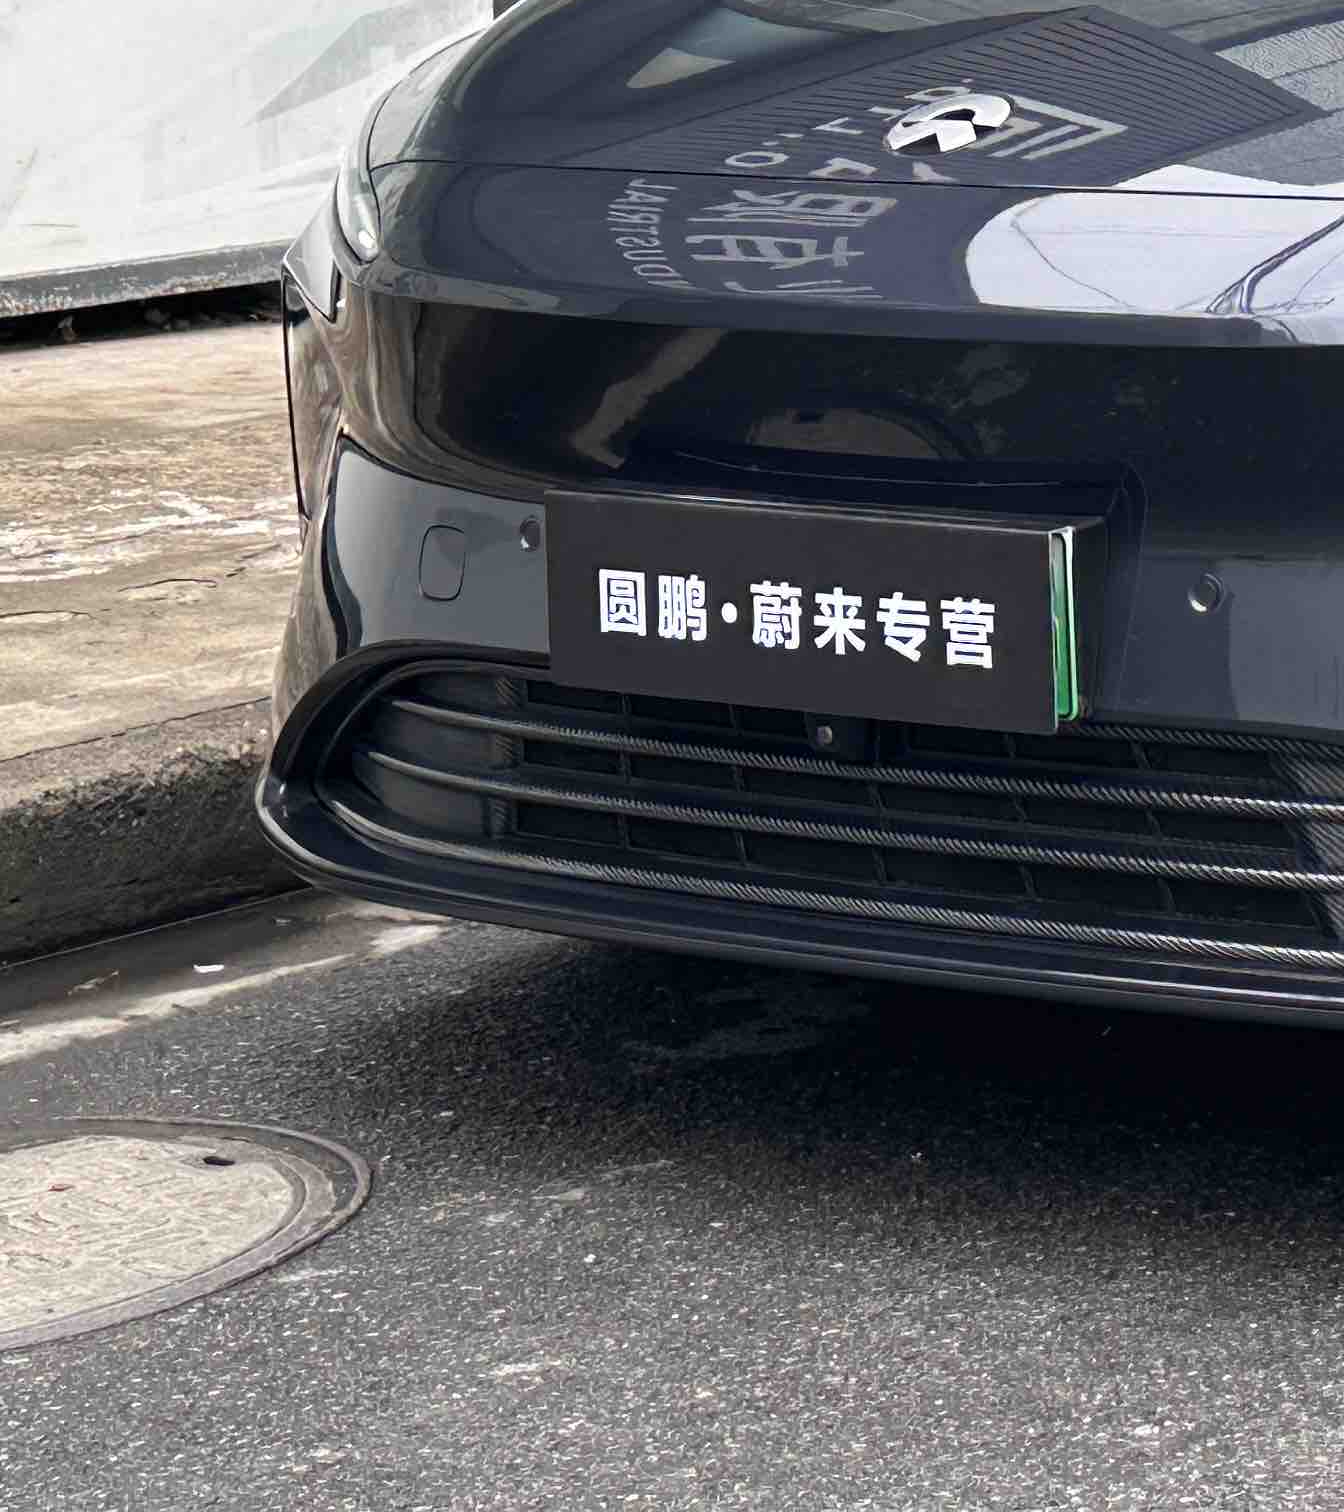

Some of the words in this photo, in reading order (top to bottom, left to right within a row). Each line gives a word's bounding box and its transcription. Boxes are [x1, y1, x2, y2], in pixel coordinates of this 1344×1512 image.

[596, 567, 998, 670] 圆鹏·蔚来专营
